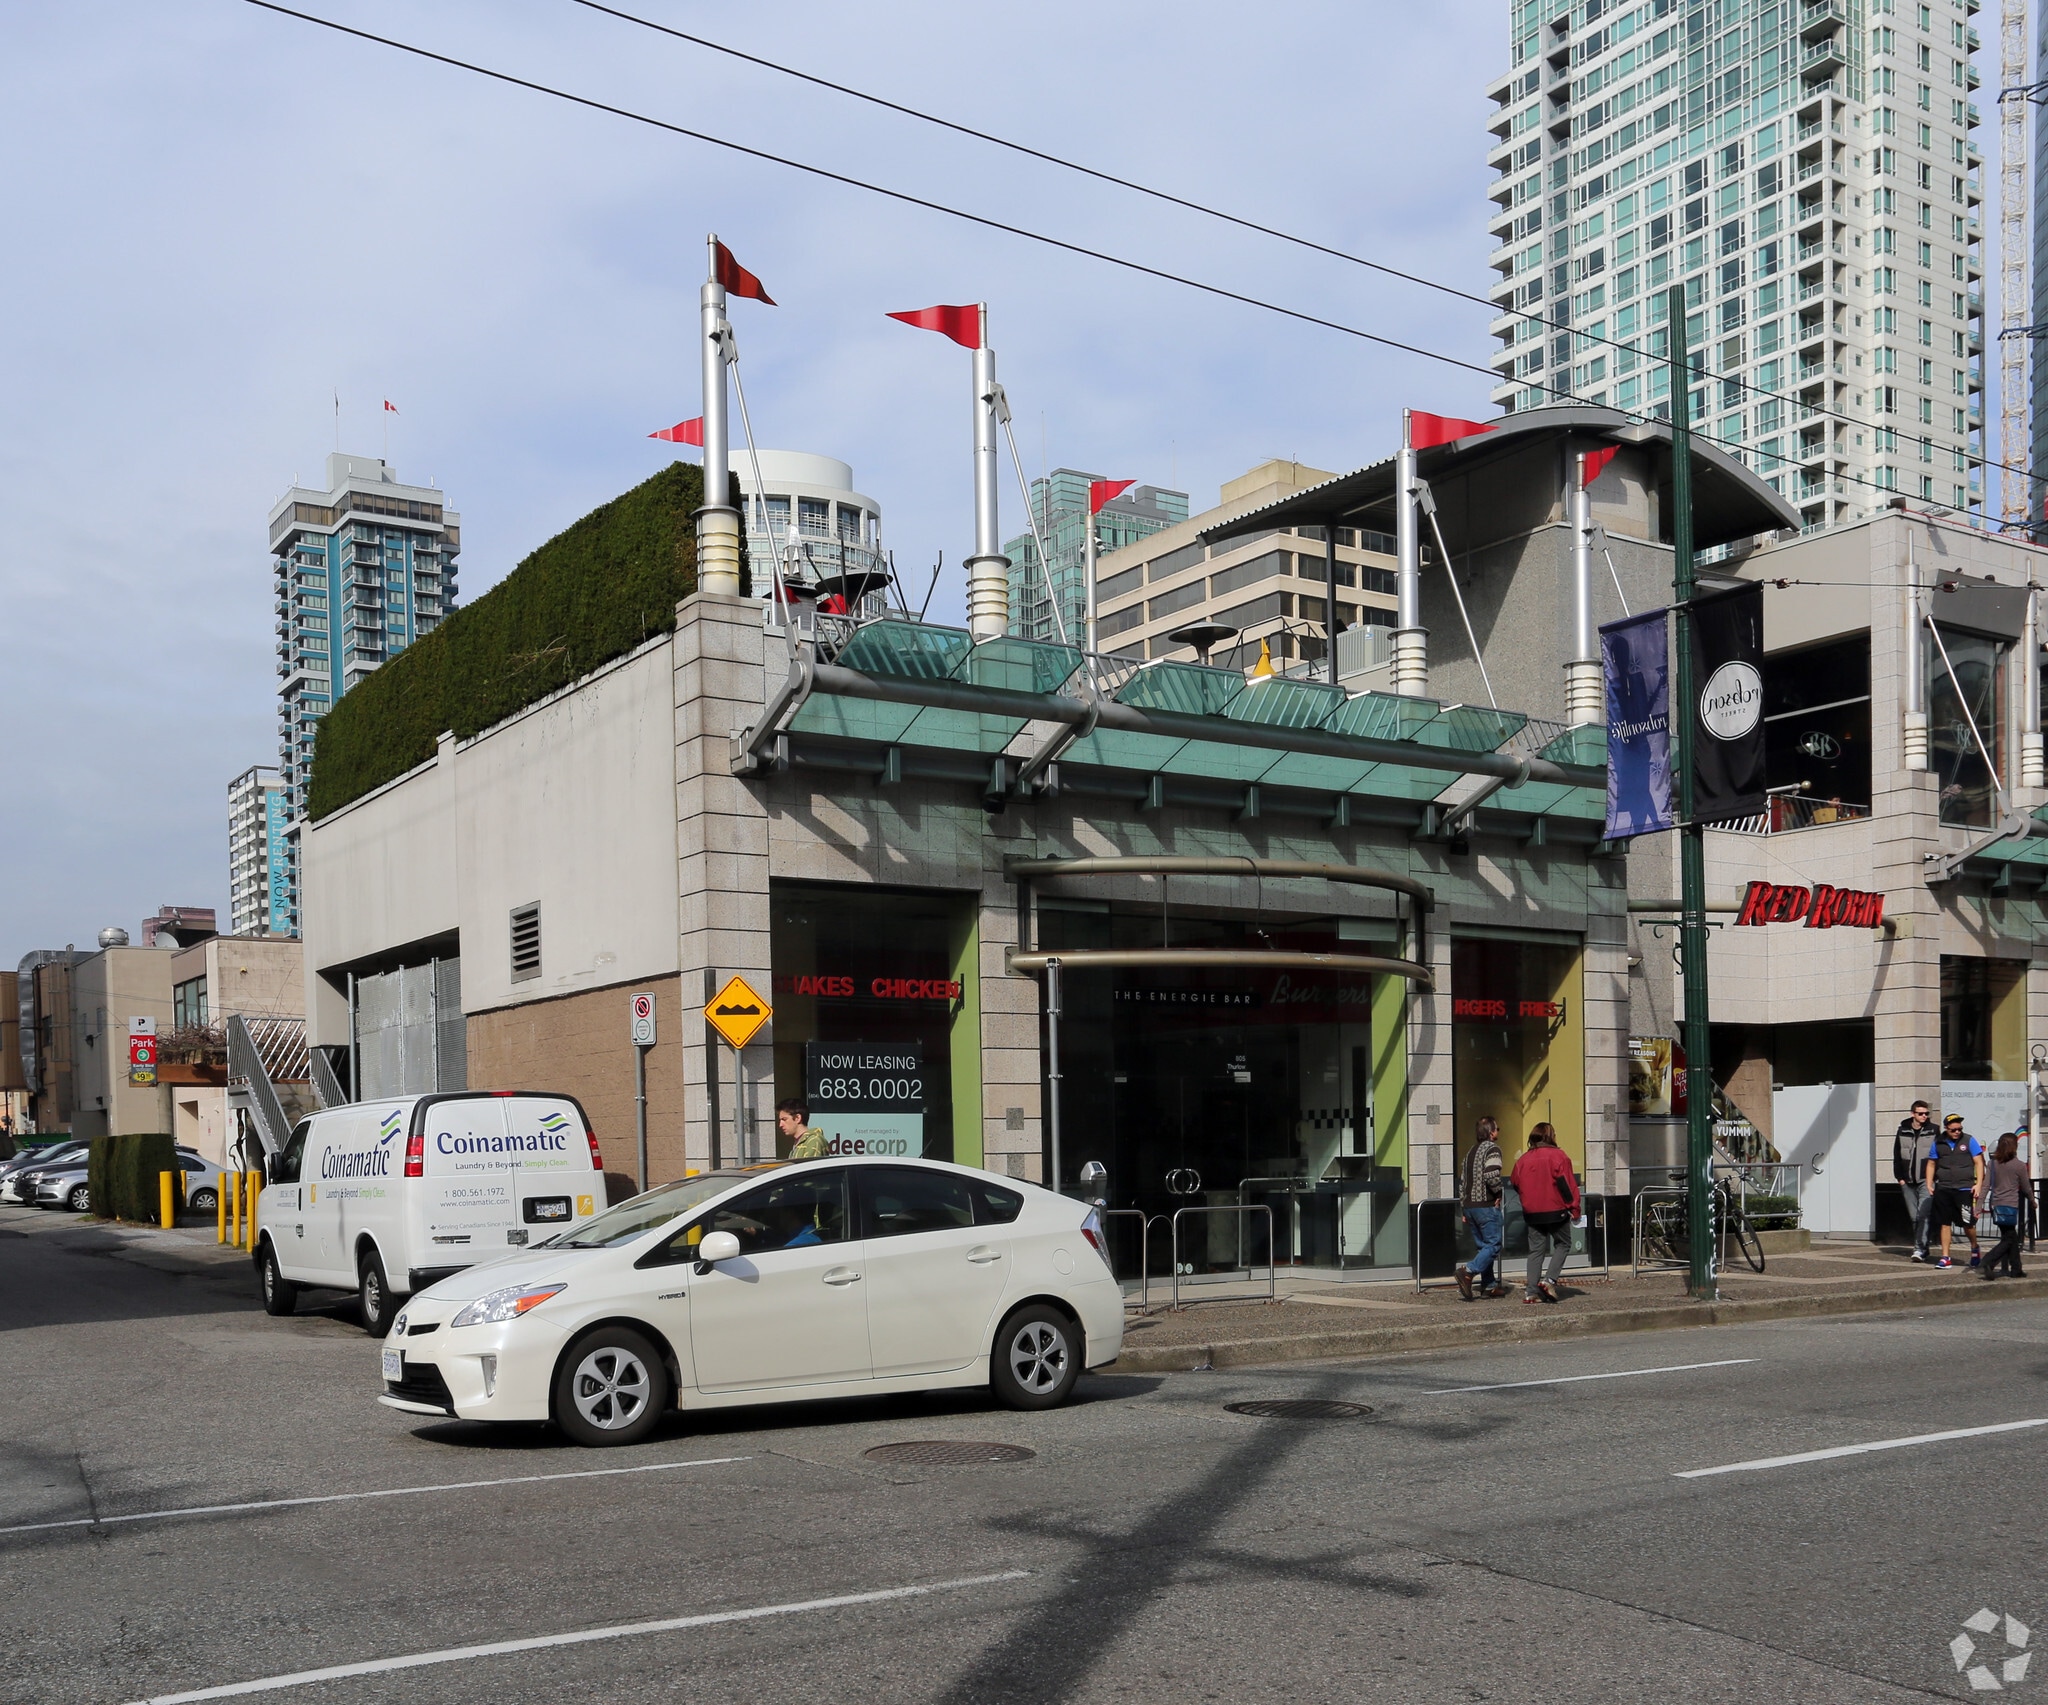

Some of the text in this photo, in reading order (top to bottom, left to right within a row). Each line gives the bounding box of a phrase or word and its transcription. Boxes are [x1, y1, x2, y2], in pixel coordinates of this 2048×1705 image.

[271, 795, 284, 867] RENTING
[274, 871, 285, 908] NOW
[1733, 880, 1885, 929] RED ROBIN
[871, 977, 959, 999] CHICKEN
[1150, 991, 1215, 1003] ENERGIE
[1224, 994, 1250, 1004] BAR
[1519, 1001, 1558, 1018] FRIES
[130, 1038, 154, 1048] Park
[820, 1054, 916, 1070] NOW LEASING
[819, 1077, 923, 1100] 683.0002
[868, 1128, 891, 1136] managed
[892, 1128, 899, 1136] by
[1716, 1126, 1751, 1137] YUMMM
[437, 1131, 567, 1155] Coinamatic
[321, 1143, 390, 1179] Coinamatic
[455, 1162, 486, 1171] Laundry
[487, 1161, 493, 1169] &
[525, 1160, 548, 1169] Simply
[451, 1187, 505, 1198] 800.561.1972
[440, 1198, 510, 1208] www.coinamatic.com
[438, 1223, 459, 1231] Serving
